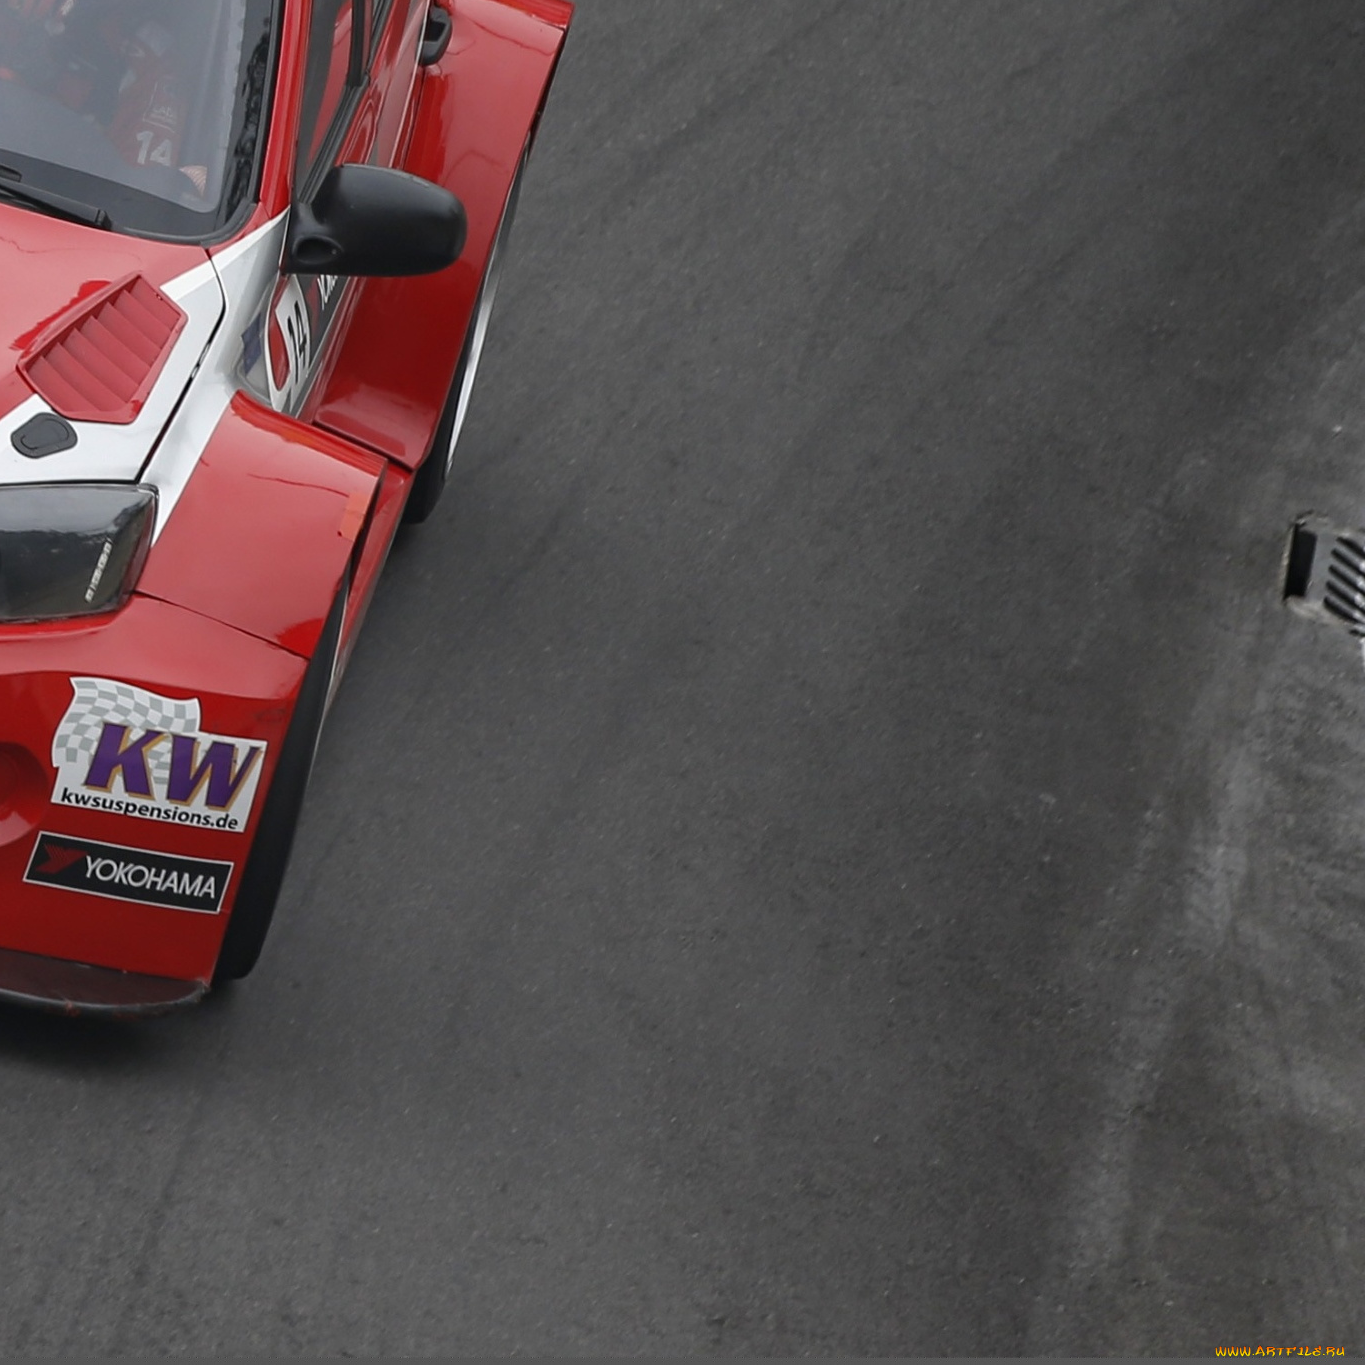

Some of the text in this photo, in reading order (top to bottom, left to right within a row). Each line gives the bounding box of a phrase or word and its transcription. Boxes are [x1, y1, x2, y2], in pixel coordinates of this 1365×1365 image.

[82, 721, 264, 813] KW
[60, 787, 239, 830] kwsuspensions.de
[85, 854, 217, 899] YOKOHAMA
